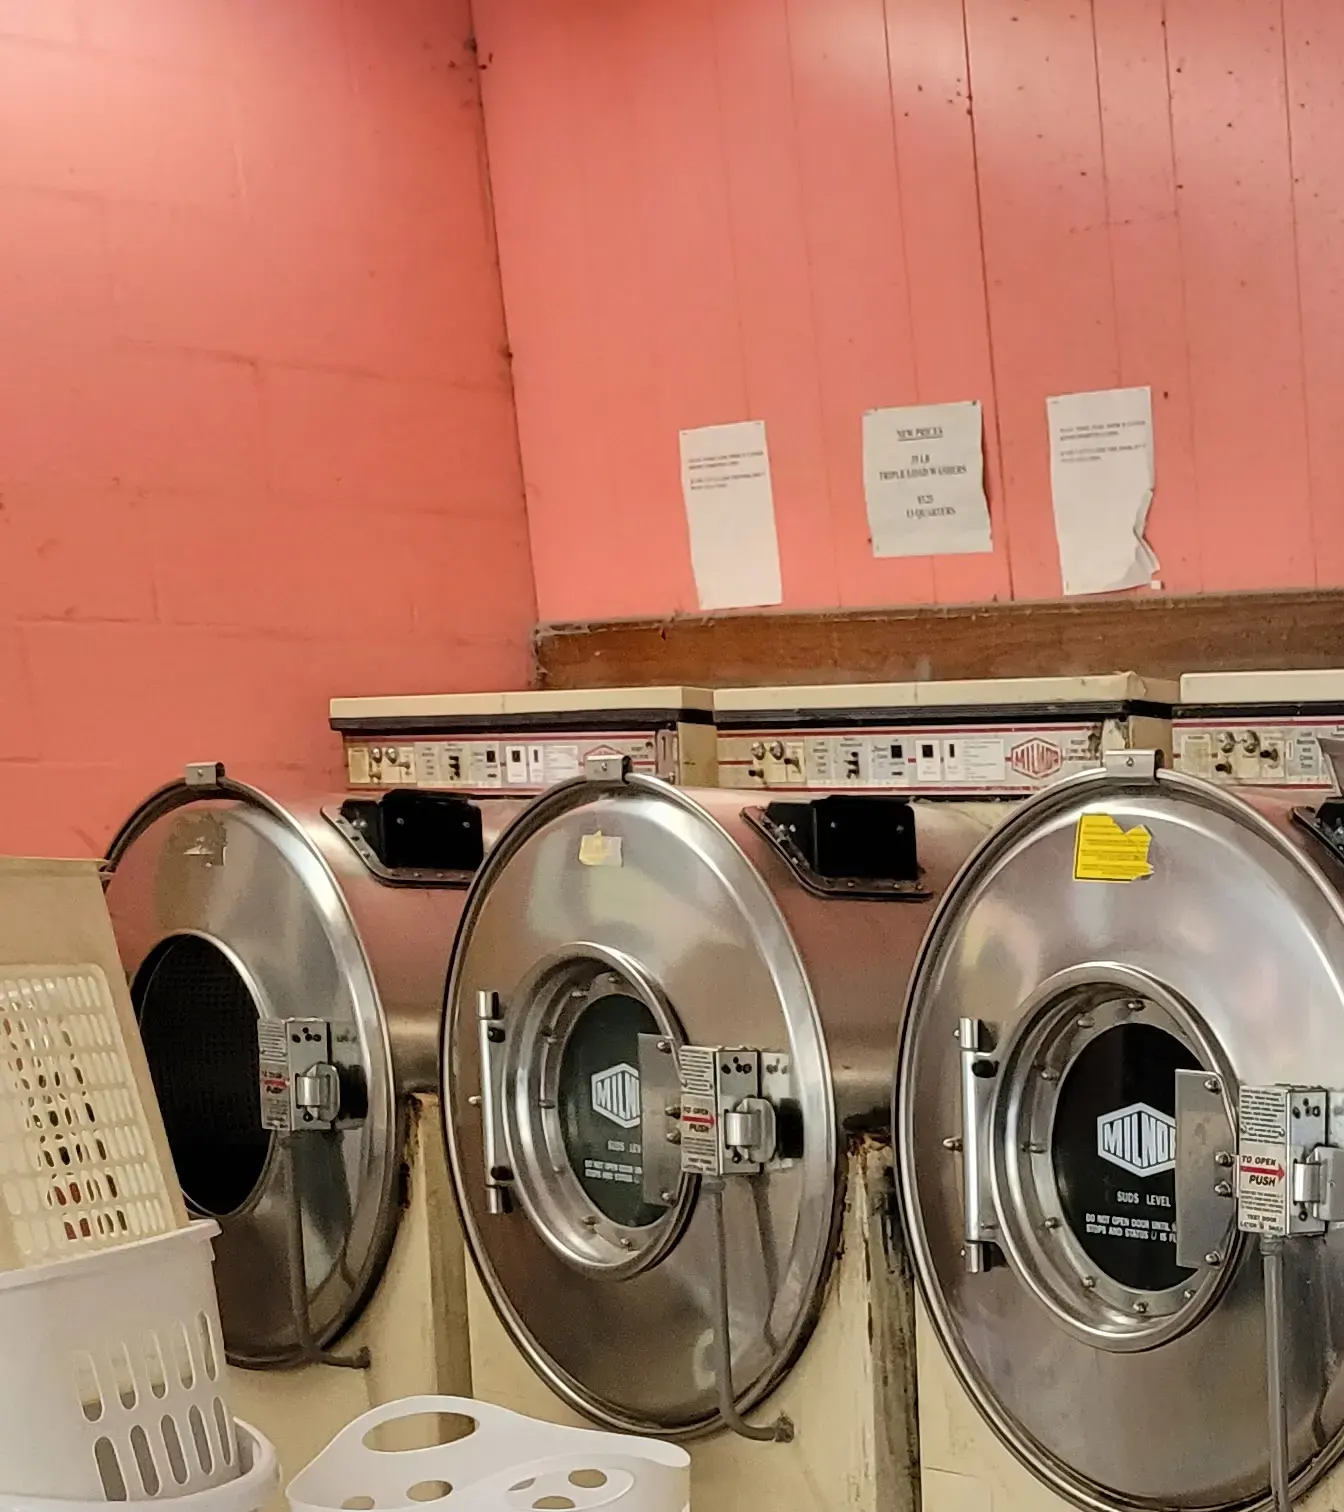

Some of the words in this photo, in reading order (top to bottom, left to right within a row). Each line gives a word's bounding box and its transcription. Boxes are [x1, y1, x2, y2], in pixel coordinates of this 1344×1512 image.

[1242, 1155, 1252, 1163] TO
[1254, 1156, 1276, 1166] OPEN
[1249, 1174, 1276, 1187] PUSH
[1117, 1191, 1139, 1204] SUDS
[1146, 1194, 1171, 1207] LEVEL
